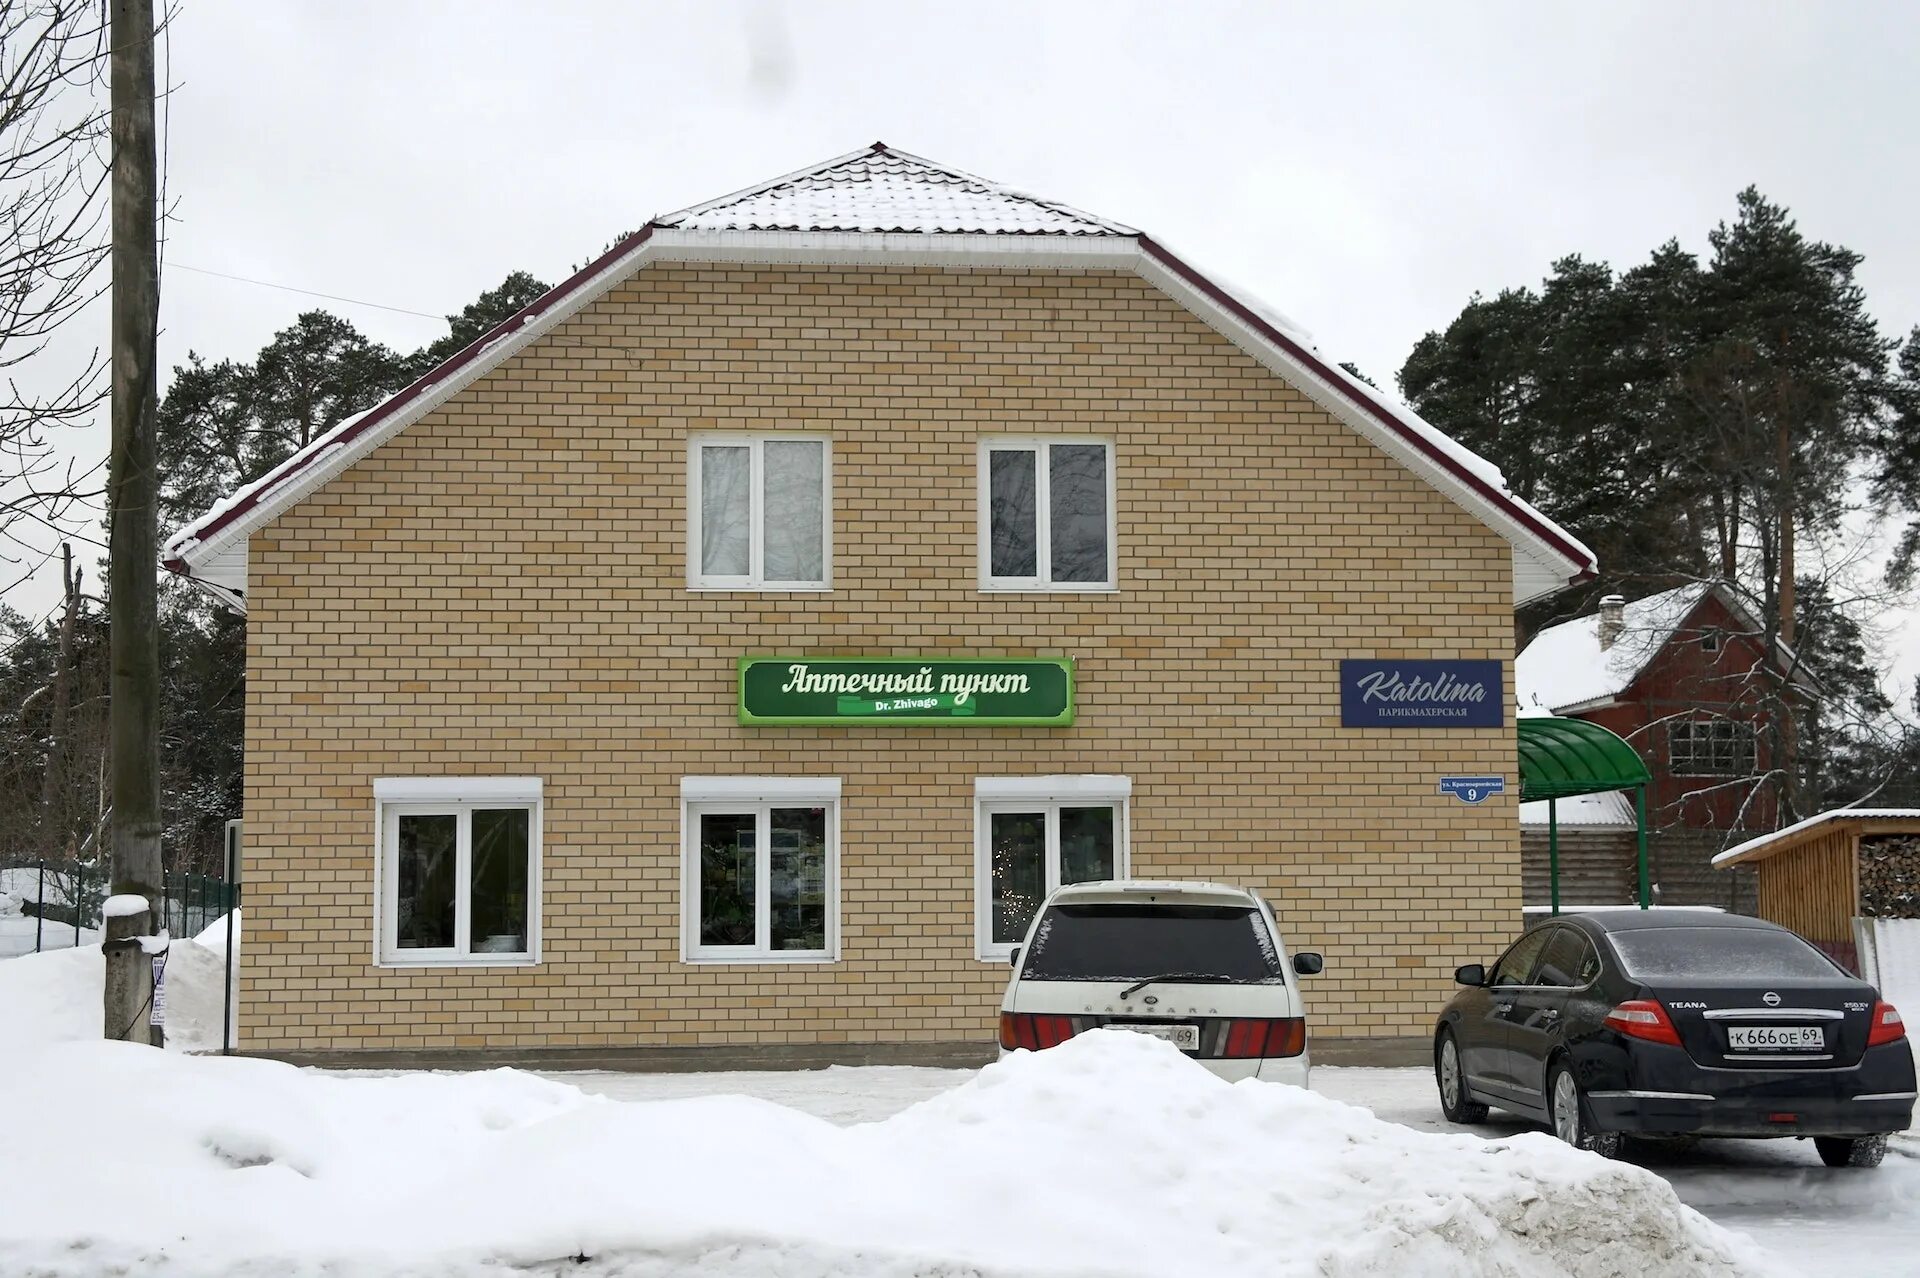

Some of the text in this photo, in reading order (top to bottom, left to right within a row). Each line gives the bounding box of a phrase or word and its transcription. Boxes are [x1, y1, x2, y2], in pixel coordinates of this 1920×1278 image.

[781, 663, 1031, 705] Аптечный пункт
[1356, 670, 1487, 704] Katolina
[875, 697, 938, 711] Dr. Zhivago
[1378, 707, 1468, 717] ПАРИКМАХЕРСКАЯ
[1468, 789, 1476, 800] 9
[1668, 1001, 1708, 1009] TEANA
[1176, 1030, 1192, 1042] 69
[1803, 1029, 1817, 1040] 69
